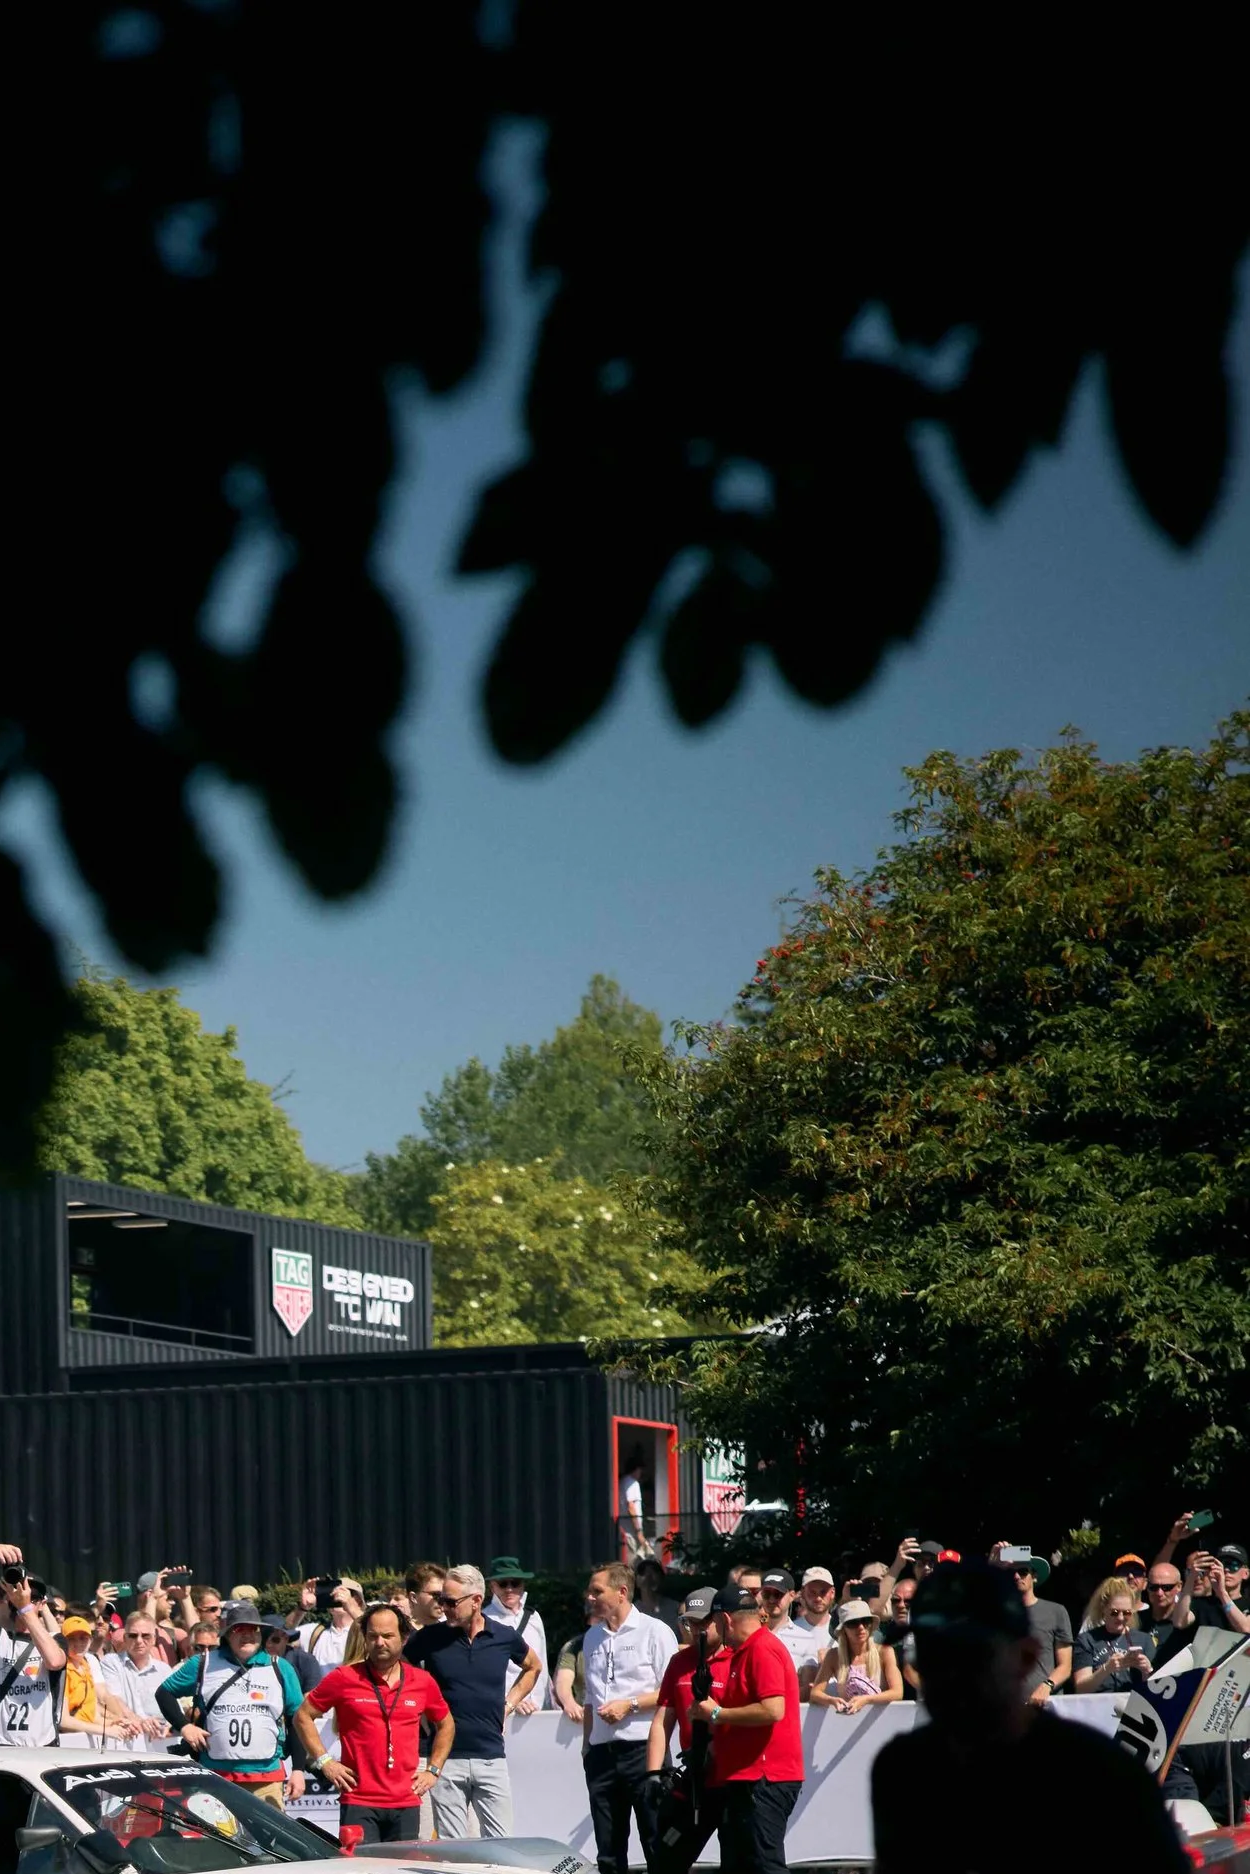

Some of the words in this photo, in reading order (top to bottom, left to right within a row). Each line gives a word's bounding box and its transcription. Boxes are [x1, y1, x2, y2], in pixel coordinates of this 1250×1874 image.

[276, 1255, 310, 1286] TAG
[322, 1264, 415, 1303] DESIGNED
[333, 1292, 362, 1322] TO
[365, 1299, 401, 1328] WIN
[6, 1702, 30, 1731] 22
[229, 1718, 252, 1748] 90
[63, 1768, 136, 1792] Audi
